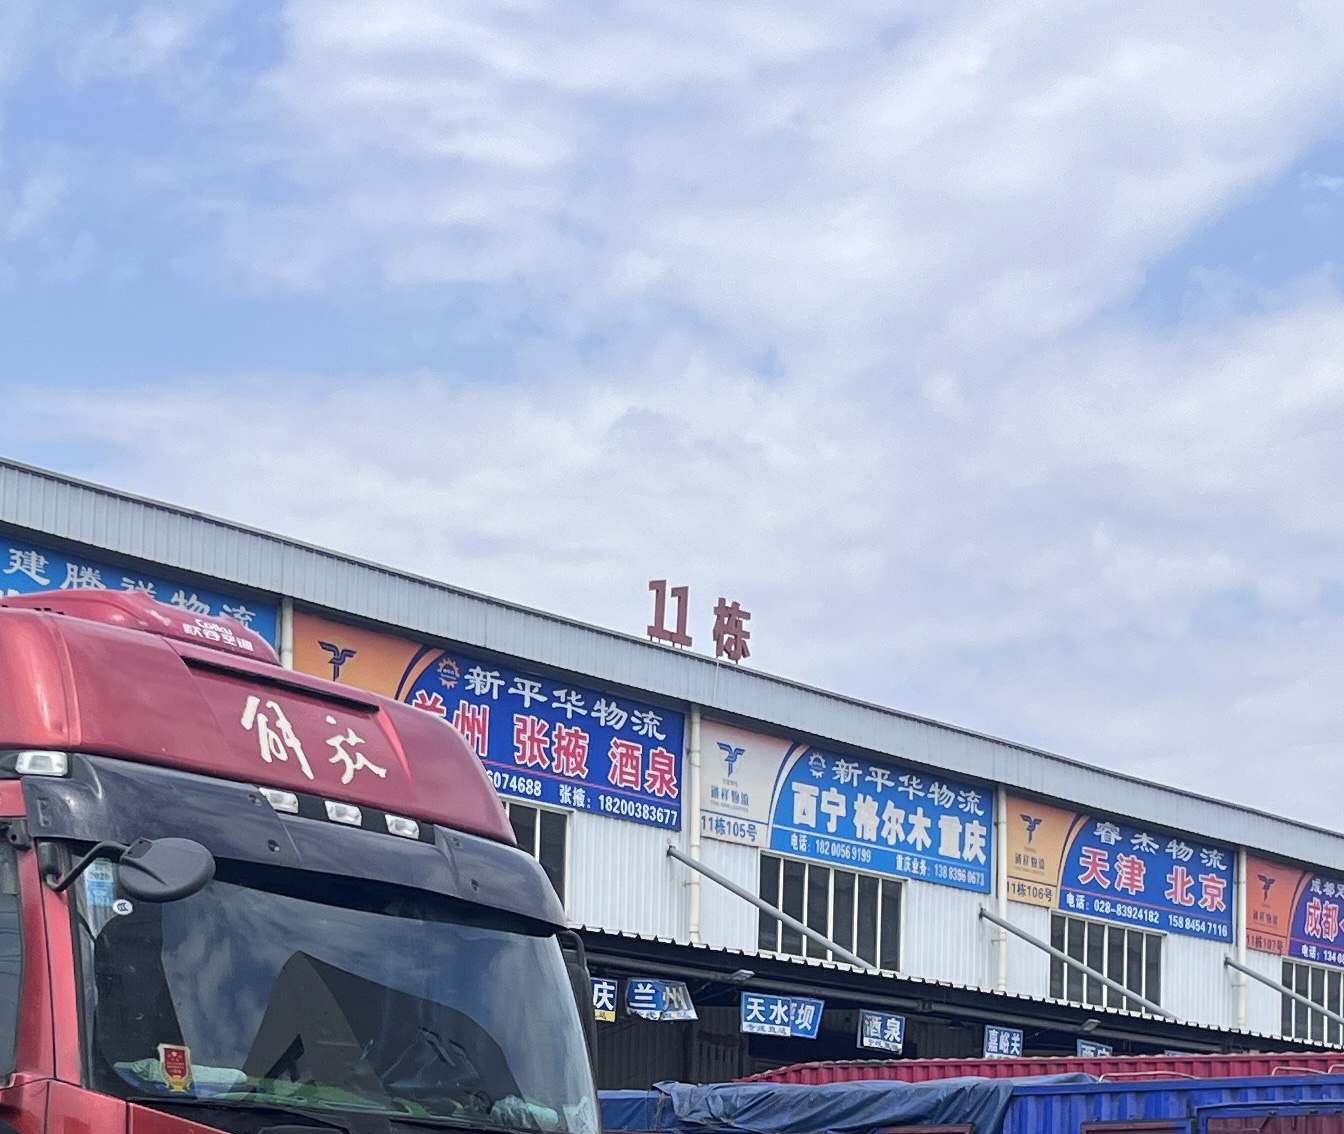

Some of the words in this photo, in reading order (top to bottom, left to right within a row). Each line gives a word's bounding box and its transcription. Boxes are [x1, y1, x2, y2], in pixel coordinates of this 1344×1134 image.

[647, 579, 693, 648] 11
[713, 597, 752, 660] 栋
[464, 665, 667, 741] 新平华物流
[513, 713, 589, 778] 张掖
[607, 737, 679, 799] 酒泉
[598, 794, 678, 826] 18200383677
[831, 758, 985, 817] 新平华物流
[701, 815, 757, 842] 11栋105号
[791, 781, 847, 833] 西宁
[853, 794, 932, 852] 格尔木
[938, 814, 988, 865] 重庆
[1093, 821, 1228, 871] 睿杰物流
[1077, 847, 1146, 895] 天津
[1164, 865, 1227, 912] 北京
[1304, 896, 1339, 943] 成都
[629, 983, 688, 1010] 兰州
[746, 997, 789, 1025] 天水
